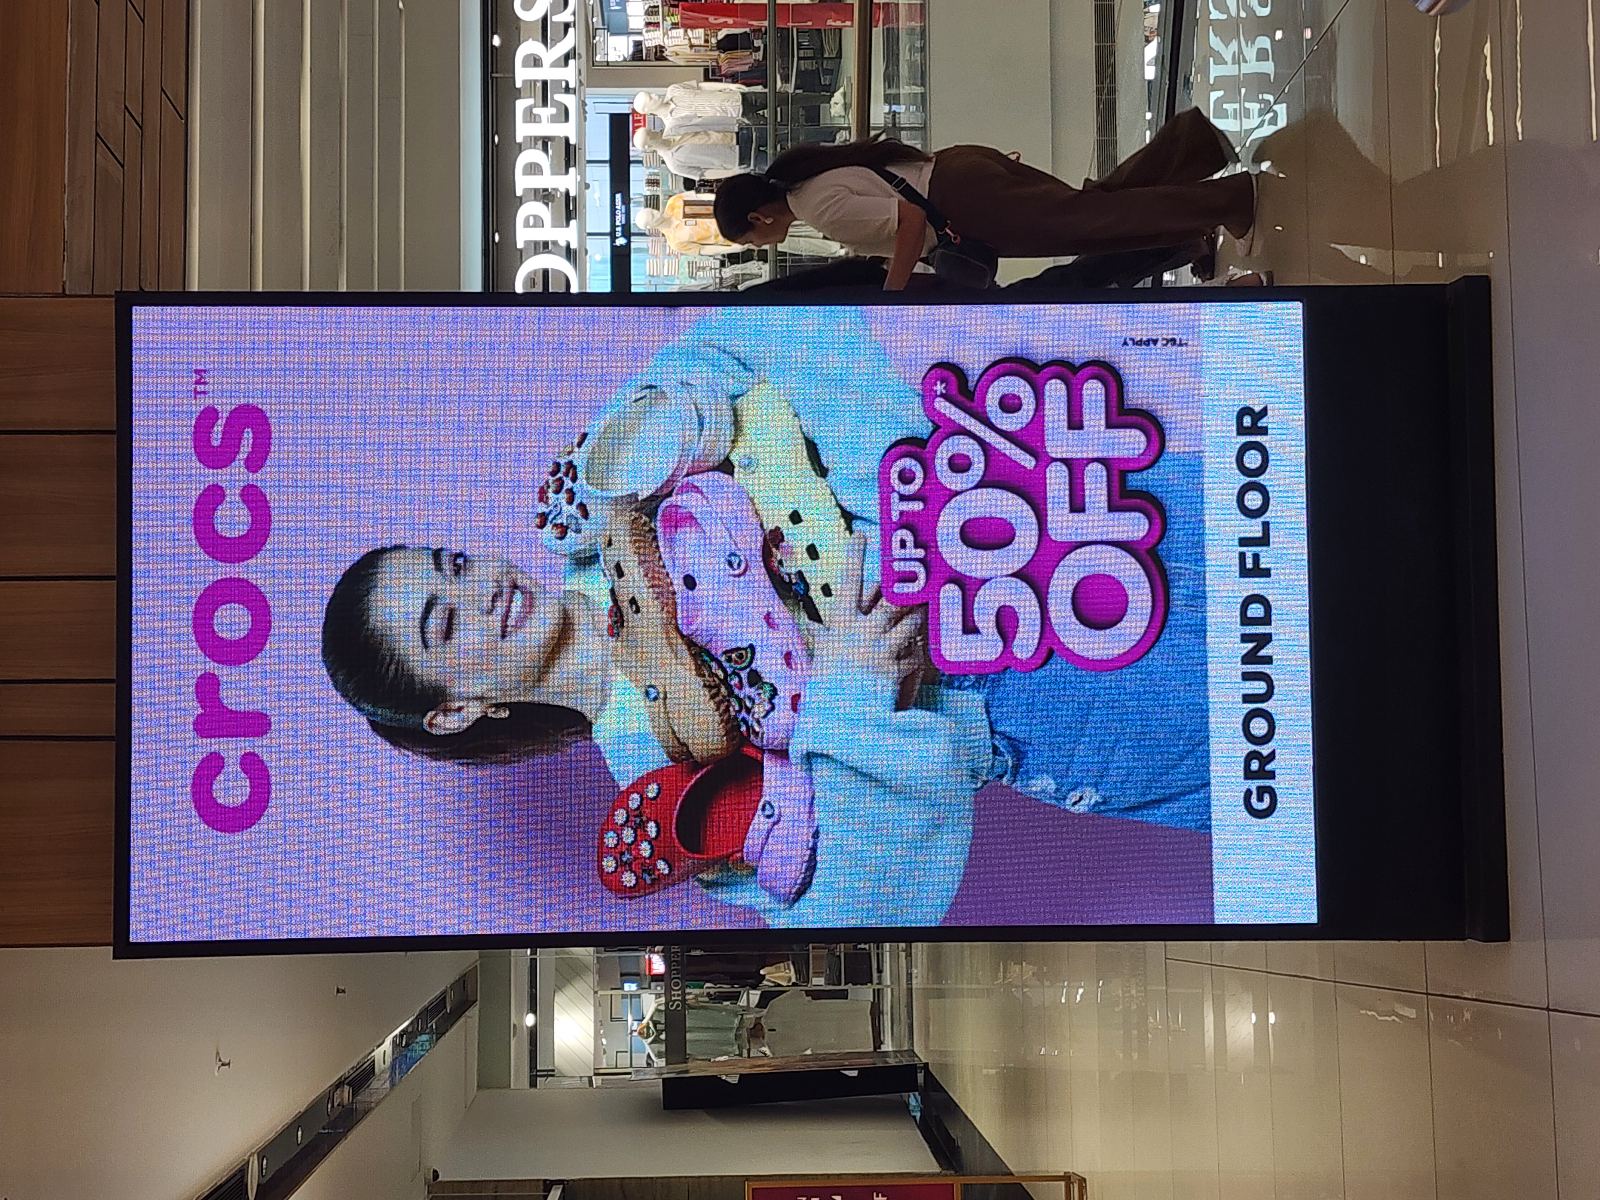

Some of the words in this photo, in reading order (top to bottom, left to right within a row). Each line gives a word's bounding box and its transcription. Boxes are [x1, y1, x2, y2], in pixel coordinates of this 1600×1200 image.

[1121, 336, 1160, 348] APPLY
[890, 457, 924, 521] TO
[892, 529, 927, 593] UP
[1044, 378, 1153, 660] OFF
[1235, 404, 1270, 579] FLOOR
[191, 404, 272, 834] crocs
[1239, 593, 1278, 820] GROUND
